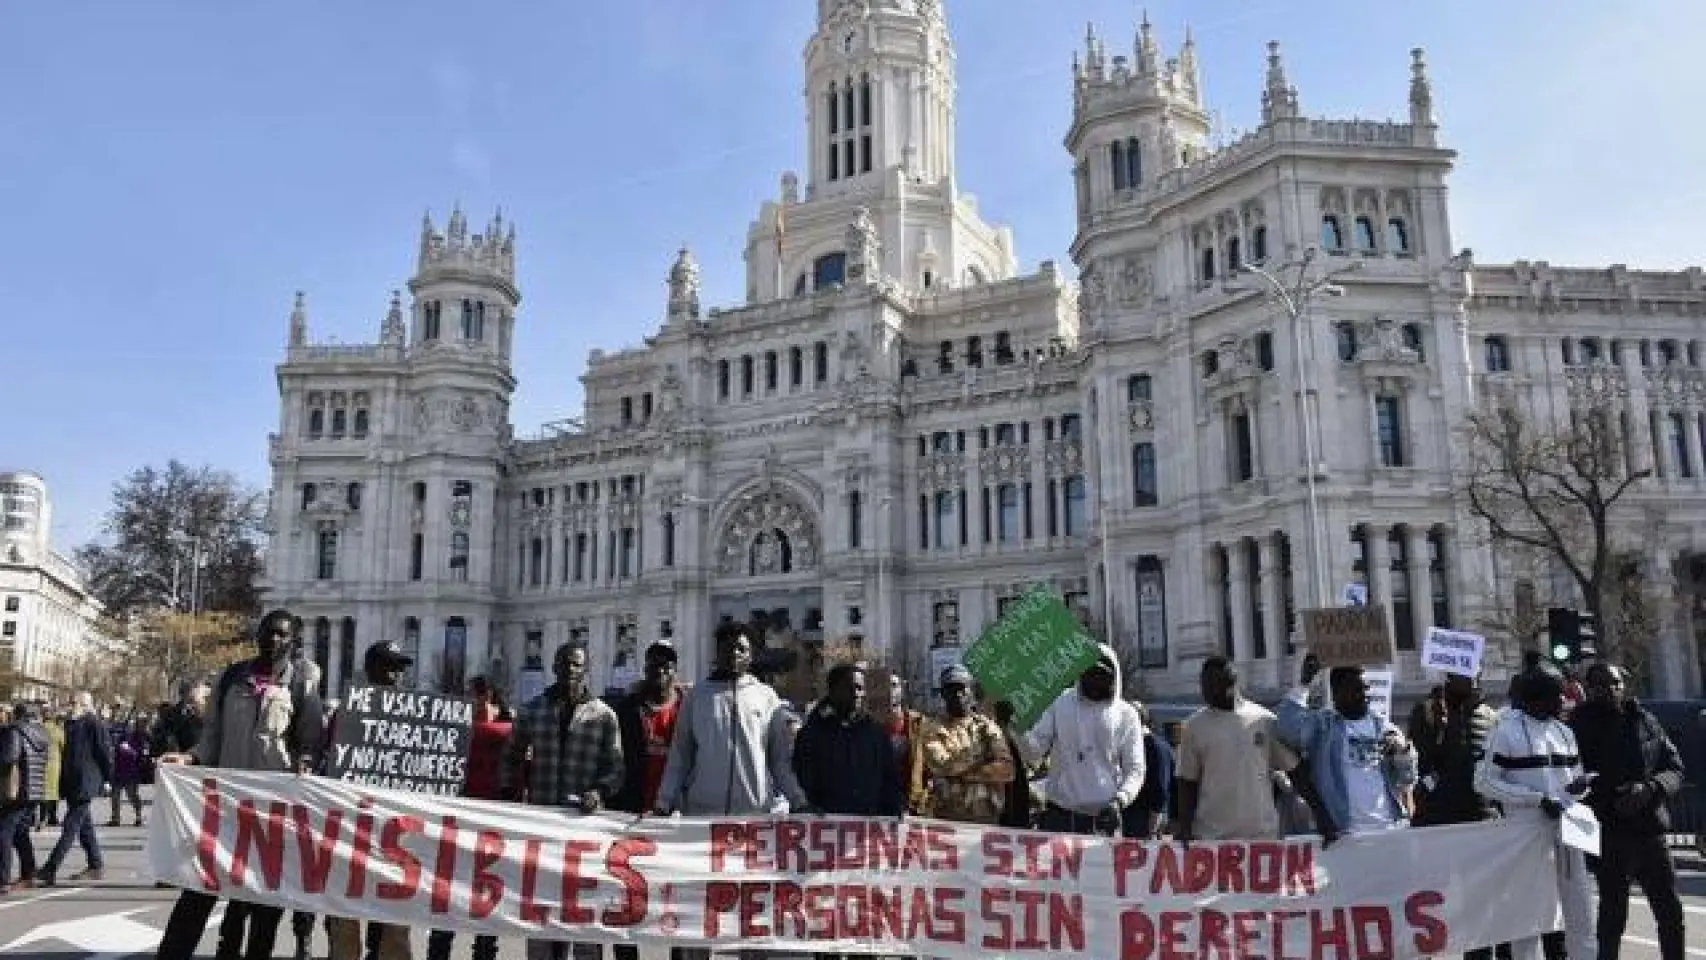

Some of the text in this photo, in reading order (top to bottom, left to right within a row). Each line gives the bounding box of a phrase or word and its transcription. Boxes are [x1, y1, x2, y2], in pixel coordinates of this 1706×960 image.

[346, 685, 474, 728] ME USAS PARA
[360, 719, 460, 754] TRABAJAR
[335, 743, 468, 782] Y NO ME QUIERES
[709, 820, 1316, 897] PERSONAS SIN PADRON
[703, 880, 1450, 960] PERSONAS SIN DERECHOS
